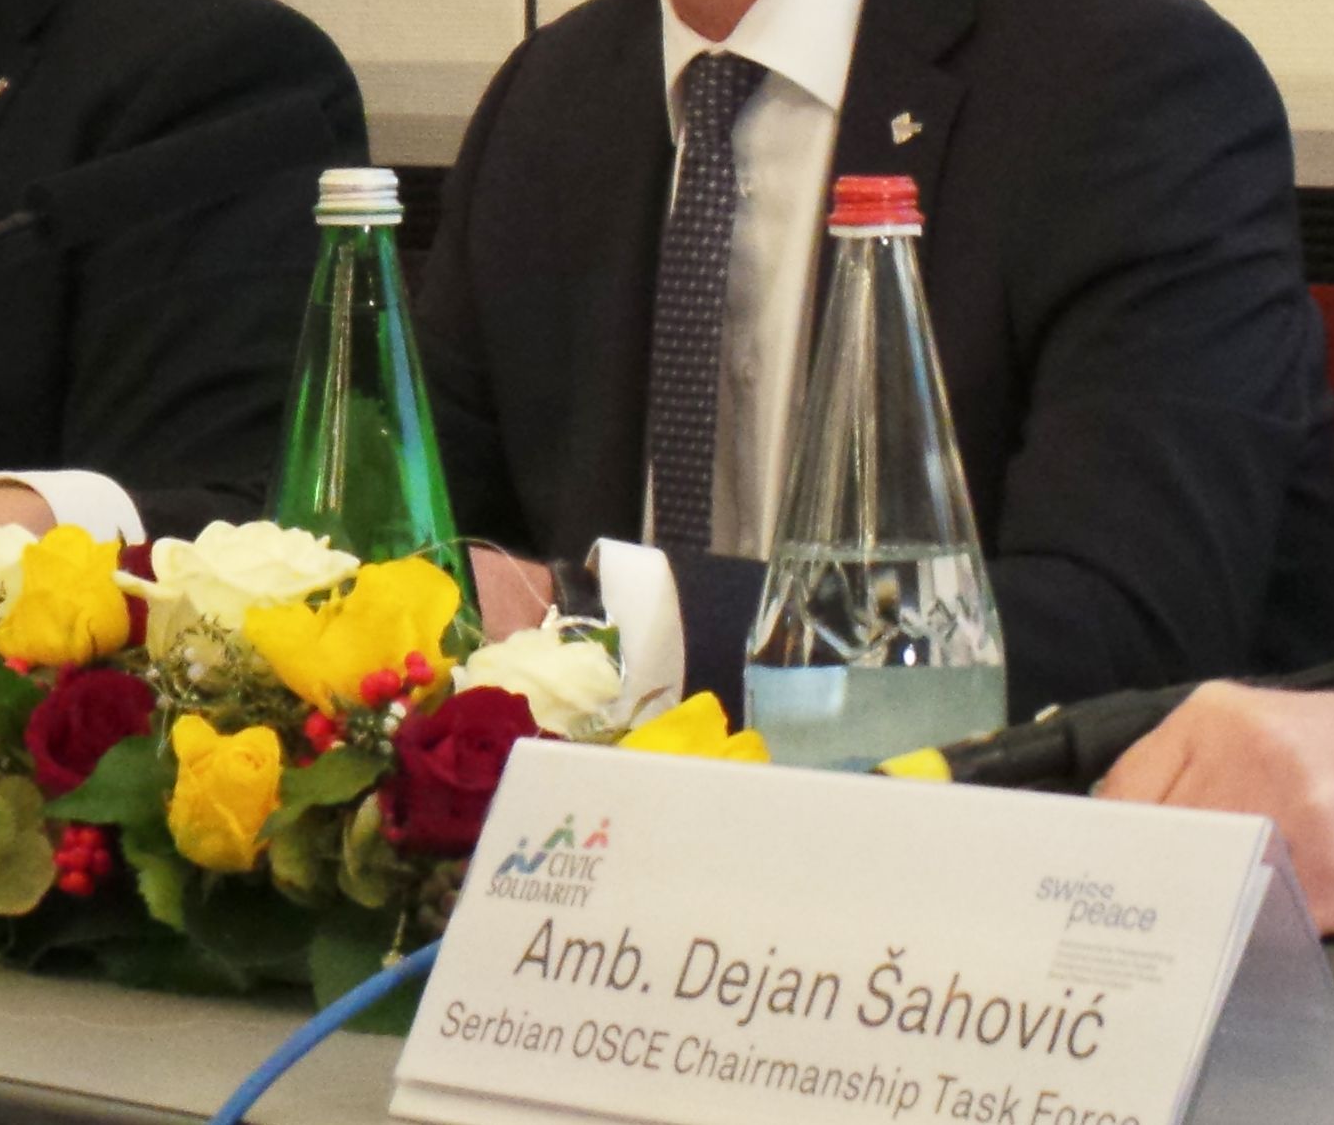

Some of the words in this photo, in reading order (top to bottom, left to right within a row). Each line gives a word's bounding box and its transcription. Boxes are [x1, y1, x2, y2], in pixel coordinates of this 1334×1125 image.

[548, 852, 603, 881] CIVIC
[486, 876, 594, 907] SOLIDARITY
[1065, 899, 1157, 931] peace
[513, 918, 650, 993] Amb.
[674, 937, 841, 1026] Dejan
[857, 946, 1106, 1060] Šahović
[441, 1000, 565, 1054] Serbian
[572, 1020, 670, 1071] OSCE
[674, 1036, 920, 1119] Chairmanship
[932, 1074, 1021, 1125] Task
